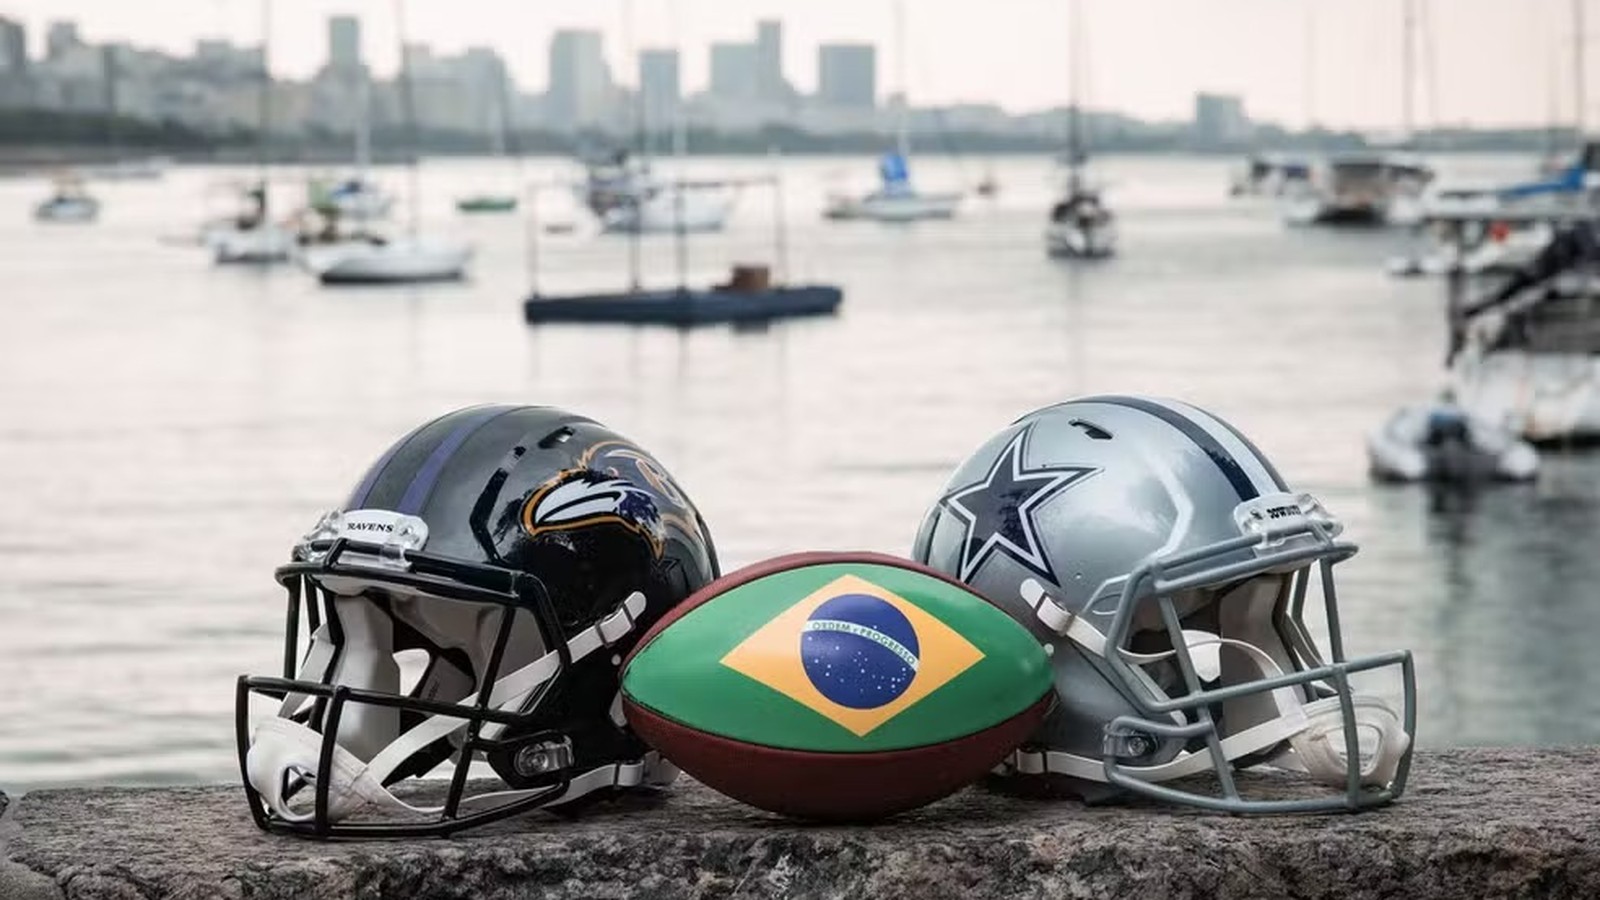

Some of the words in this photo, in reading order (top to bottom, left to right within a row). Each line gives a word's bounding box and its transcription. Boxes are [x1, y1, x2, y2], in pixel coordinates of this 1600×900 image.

[347, 522, 394, 533] RAVENS
[812, 621, 851, 631] ORDEM
[860, 628, 915, 664] PROGRESSO
